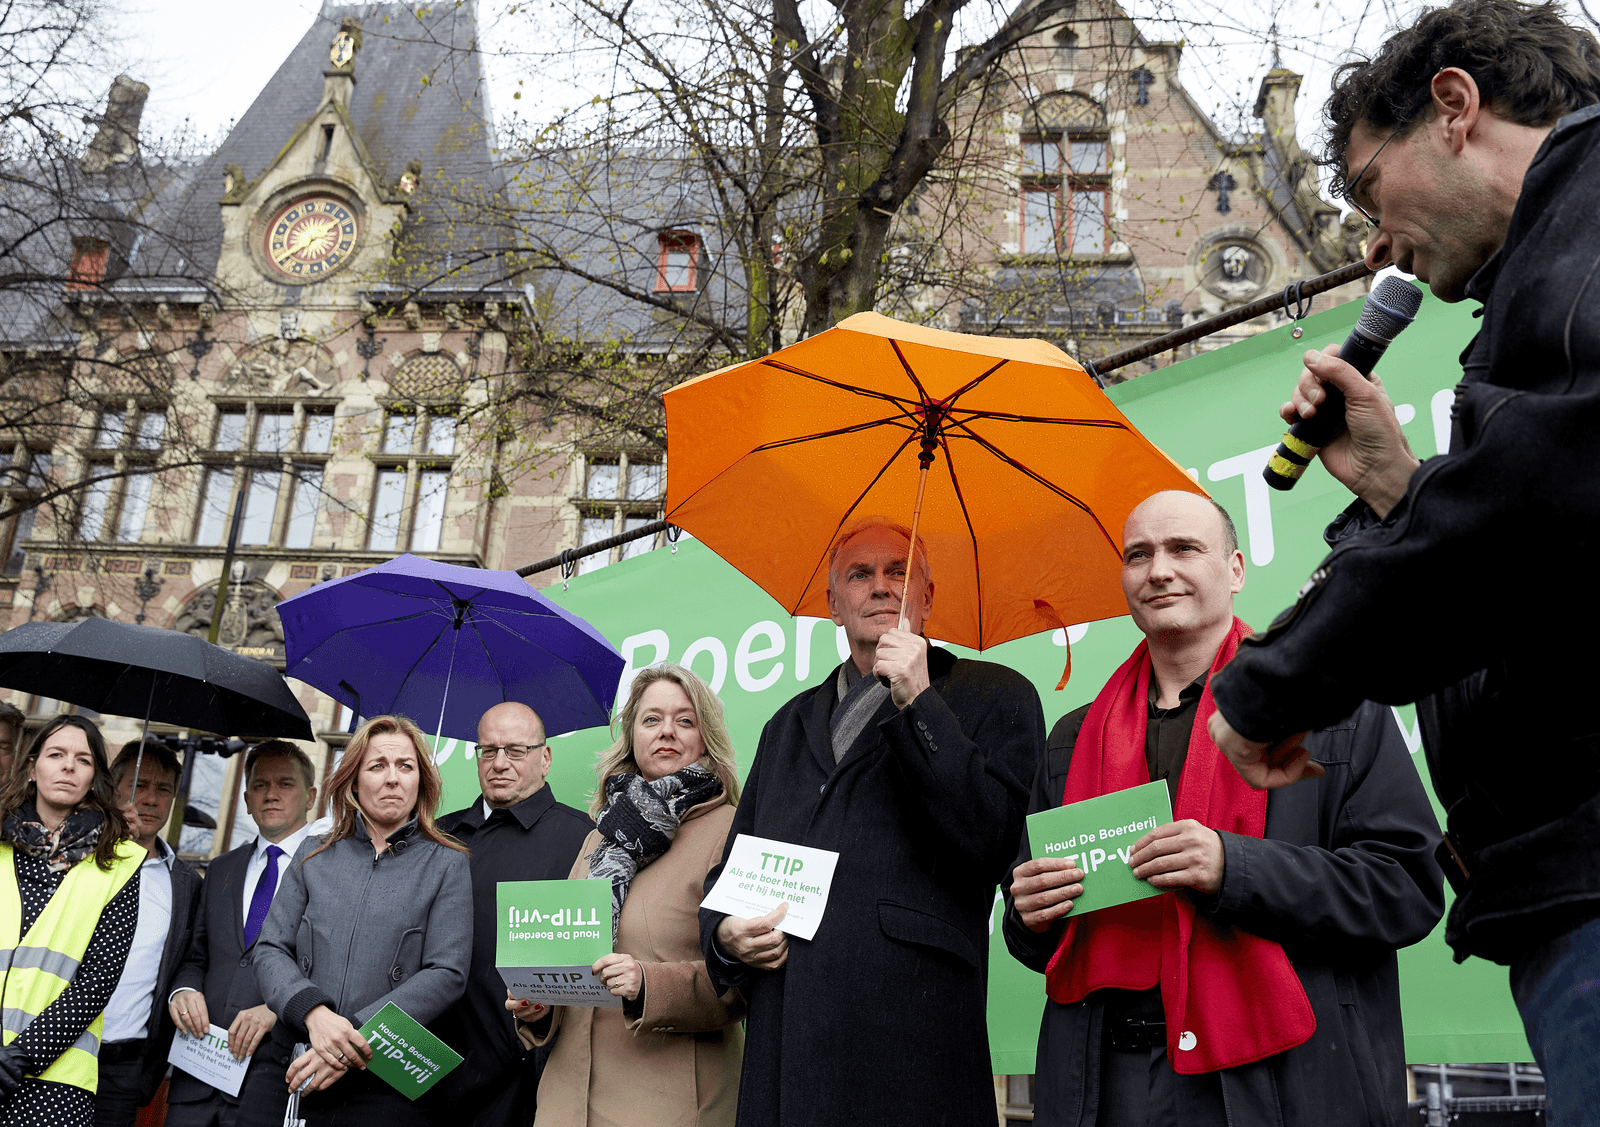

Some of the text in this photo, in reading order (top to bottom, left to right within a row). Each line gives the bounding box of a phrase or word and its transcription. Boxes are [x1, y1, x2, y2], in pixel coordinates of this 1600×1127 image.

[1044, 816, 1156, 854] Houd De Boerderij
[761, 852, 804, 876] TTIP
[728, 867, 823, 897] Als de boer het kent,
[738, 881, 805, 904] eet hij het niet
[508, 906, 601, 928] TTIP-vrij
[508, 930, 600, 941] Houd De Boerderij
[532, 972, 584, 983] TTIP
[548, 988, 562, 996] hij
[190, 1039, 198, 1047] de
[199, 1044, 214, 1054] boer
[214, 1051, 226, 1060] het
[207, 1034, 229, 1050] TIP
[378, 1022, 440, 1071] Houd De Boerderij
[186, 1045, 231, 1071] eet hij het niet
[367, 1030, 432, 1084] TTIP-vrij
